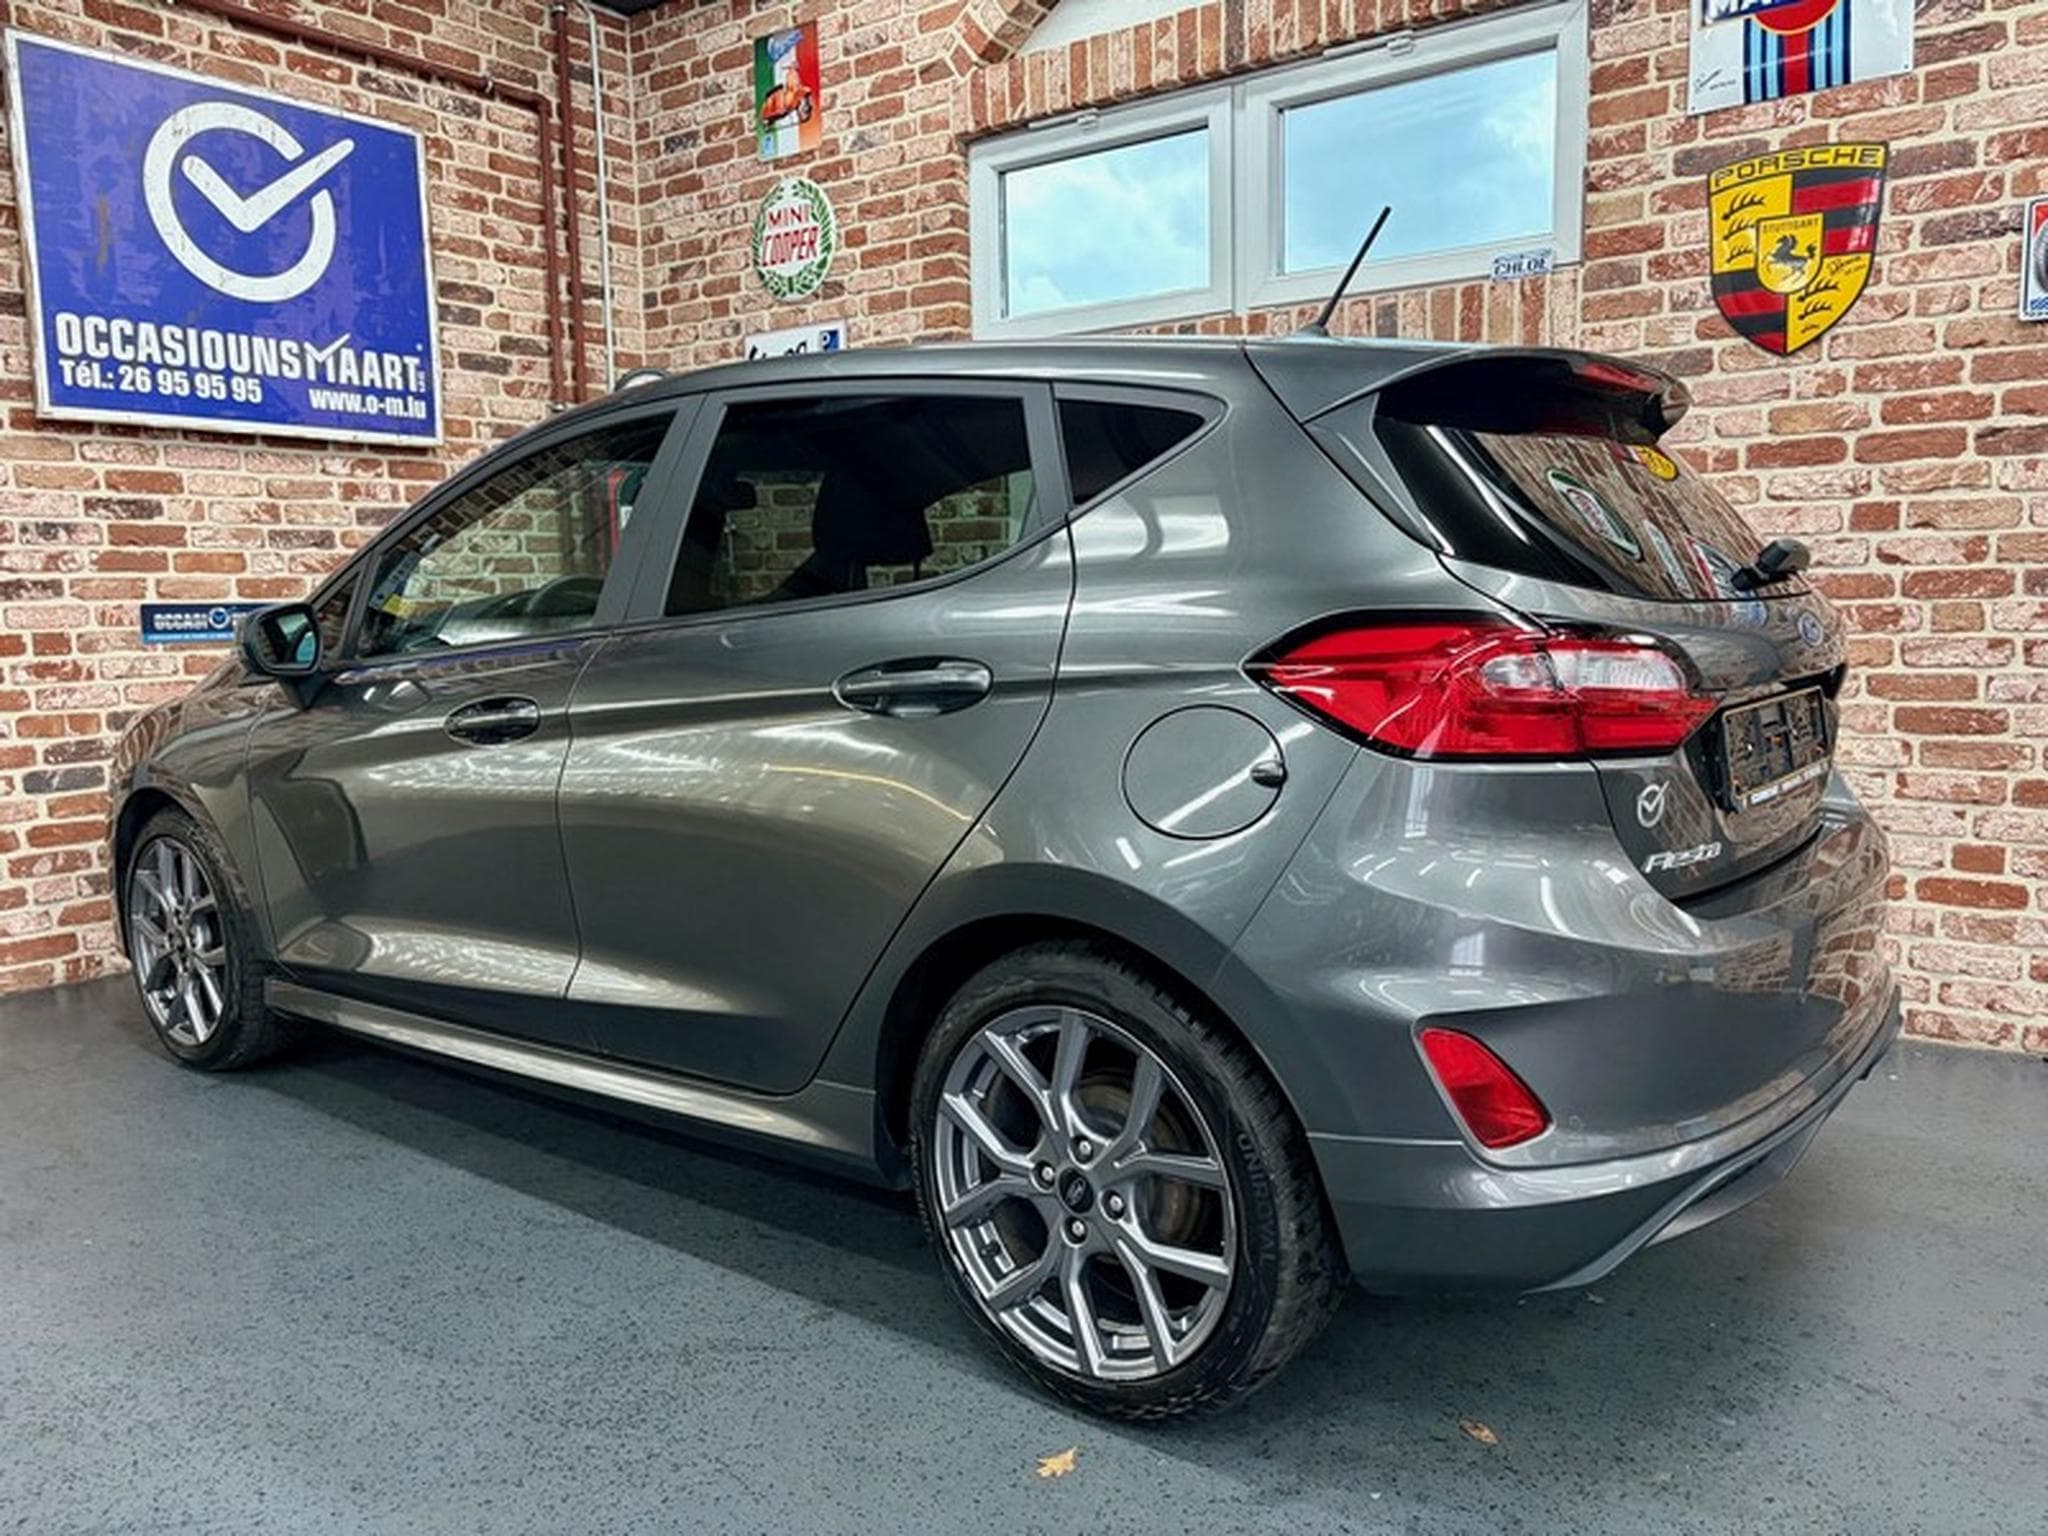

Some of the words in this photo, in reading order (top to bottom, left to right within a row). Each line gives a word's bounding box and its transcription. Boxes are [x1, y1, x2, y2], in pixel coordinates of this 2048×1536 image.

[1714, 148, 1881, 187] PORSCHE
[768, 203, 810, 228] MINI
[762, 226, 819, 267] COOPER
[59, 358, 115, 391] Tél.:
[118, 365, 152, 393] 26
[156, 368, 191, 397] 95
[194, 372, 227, 400] 95
[231, 376, 262, 403] 95
[308, 388, 427, 419] www.o-m.lu
